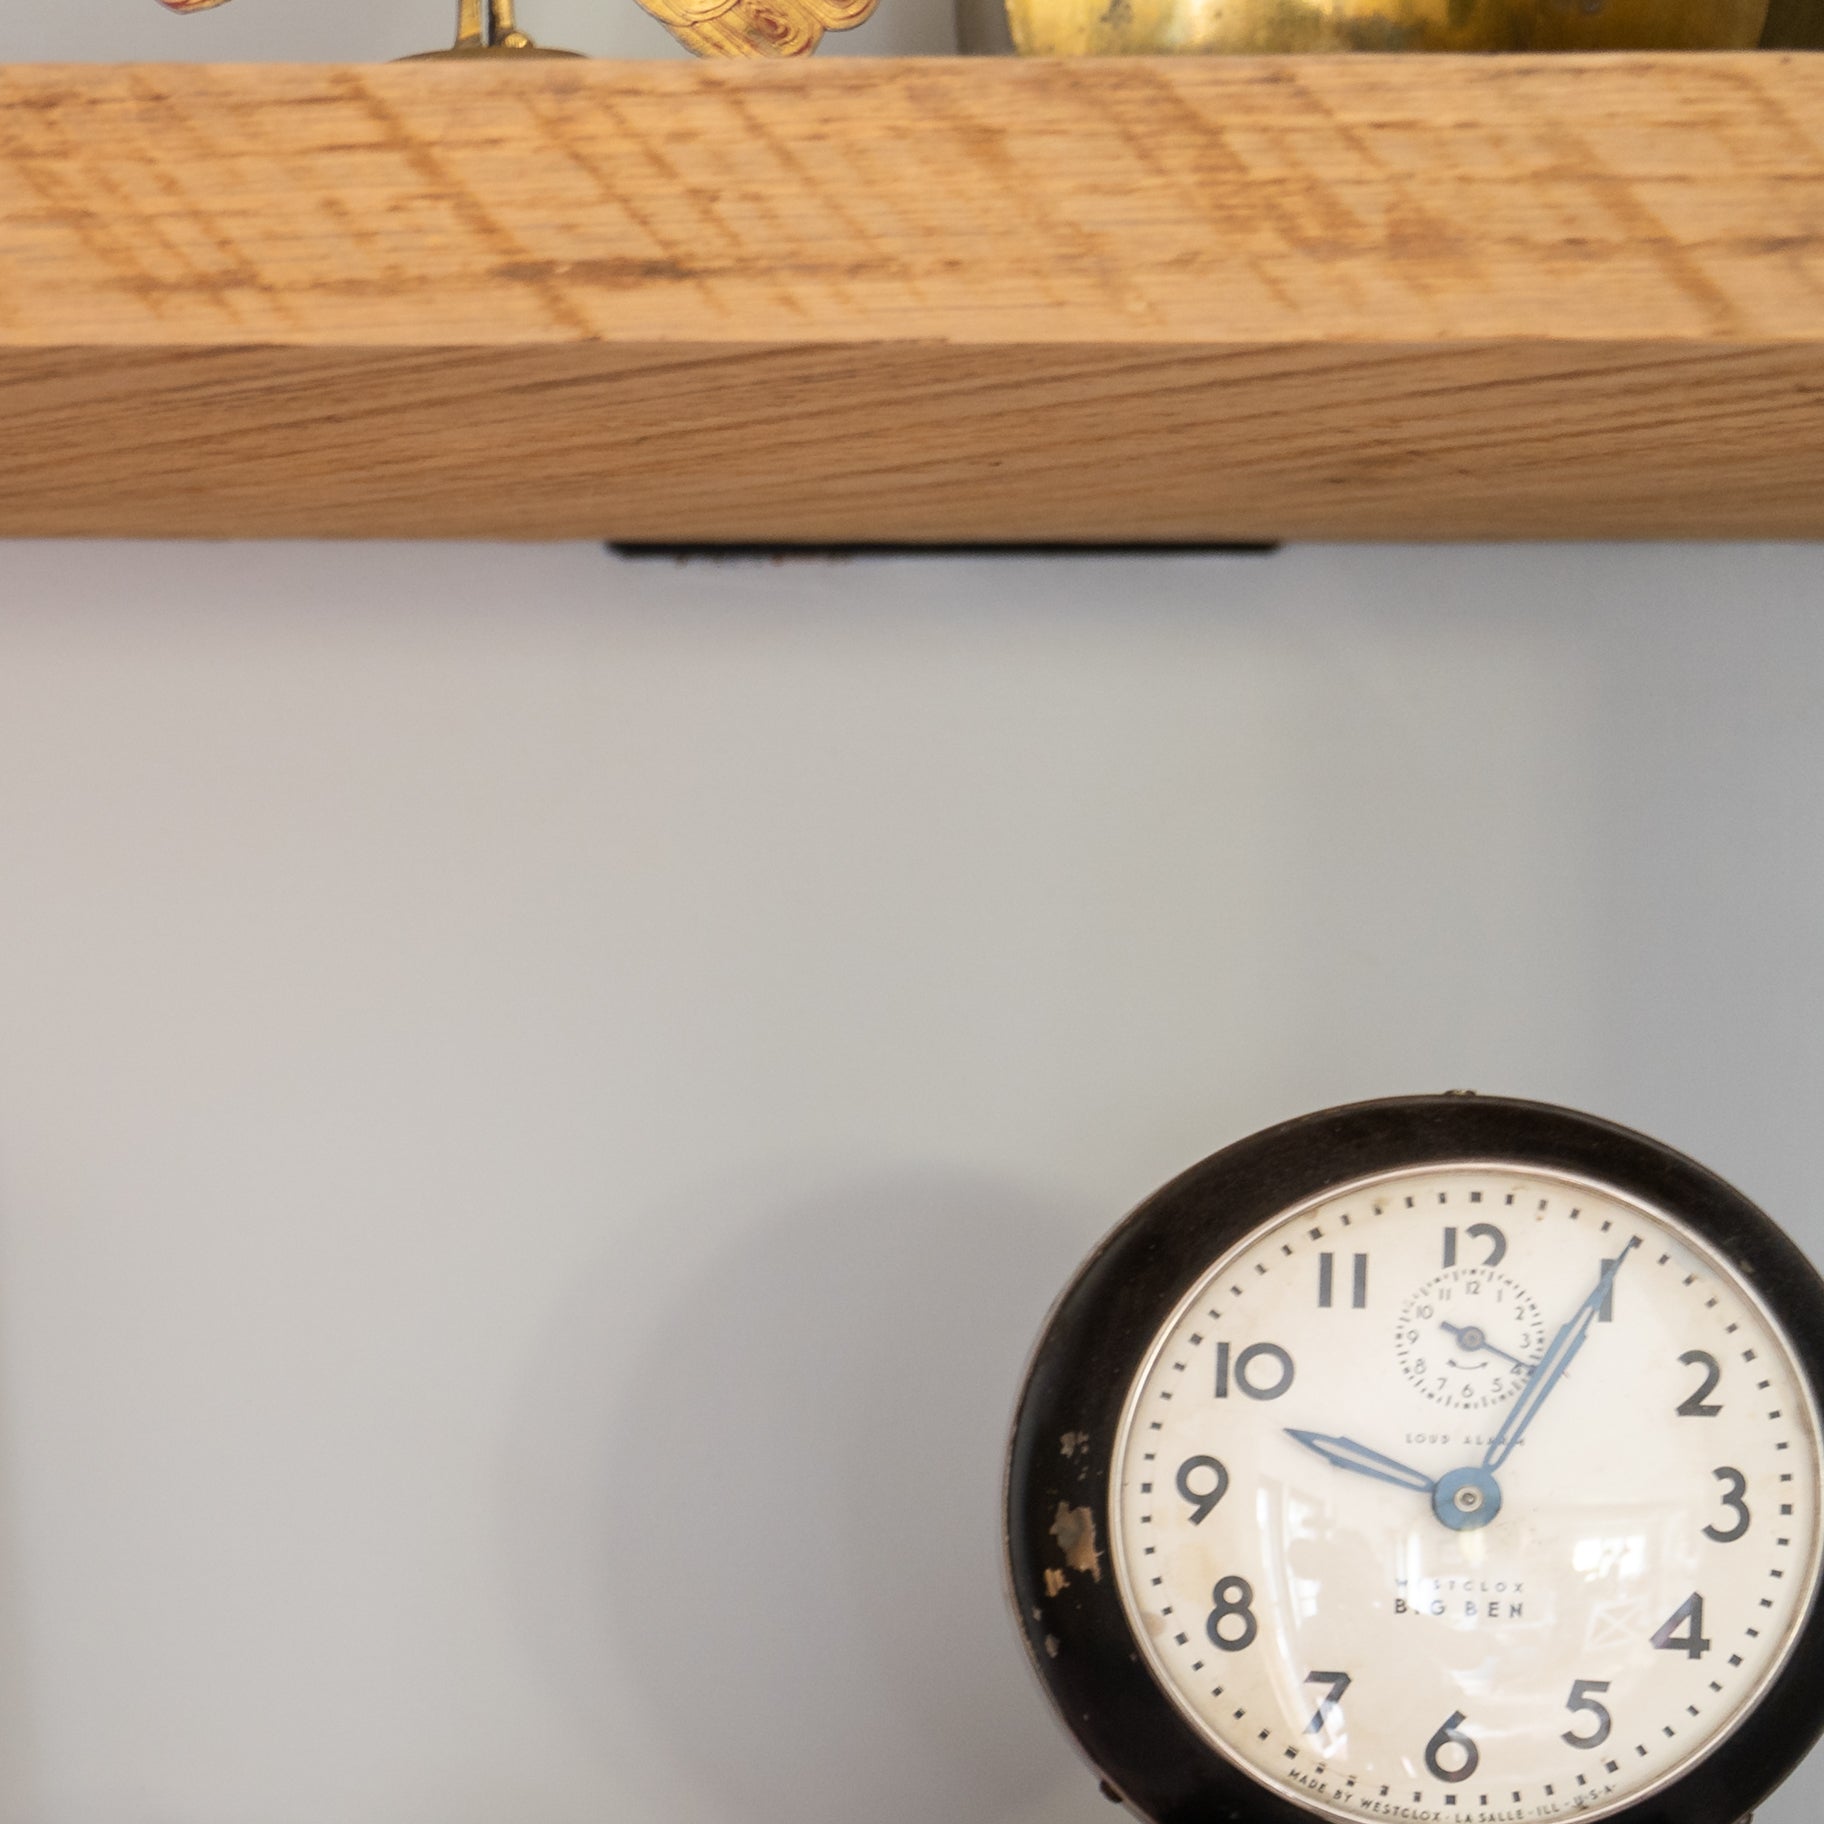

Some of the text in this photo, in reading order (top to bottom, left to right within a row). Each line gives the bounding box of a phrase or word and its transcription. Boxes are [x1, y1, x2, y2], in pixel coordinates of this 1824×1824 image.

[1443, 1223, 1507, 1268] 12
[1318, 1252, 1368, 1308] 11
[1466, 1281, 1480, 1295] 12
[1515, 1306, 1524, 1320] 2
[1407, 1330, 1419, 1344] 9
[1520, 1333, 1530, 1348] 3
[1214, 1342, 1295, 1400] 10
[1414, 1358, 1426, 1374] 8
[1437, 1378, 1447, 1391] 7
[1492, 1378, 1503, 1392] 5
[1675, 1350, 1723, 1417] 2
[1462, 1384, 1474, 1398] 6
[1176, 1455, 1230, 1526] 9
[1702, 1466, 1750, 1543] 3
[1395, 1579, 1523, 1592] WSTCLOX
[1206, 1575, 1257, 1651] 8
[1395, 1598, 1523, 1618] BG BEN
[1650, 1592, 1710, 1659] 4
[1303, 1670, 1352, 1734] 7
[1561, 1680, 1612, 1749] 5
[1425, 1711, 1479, 1783] 6
[1288, 1769, 1328, 1794] MADE
[1333, 1790, 1353, 1803] BY
